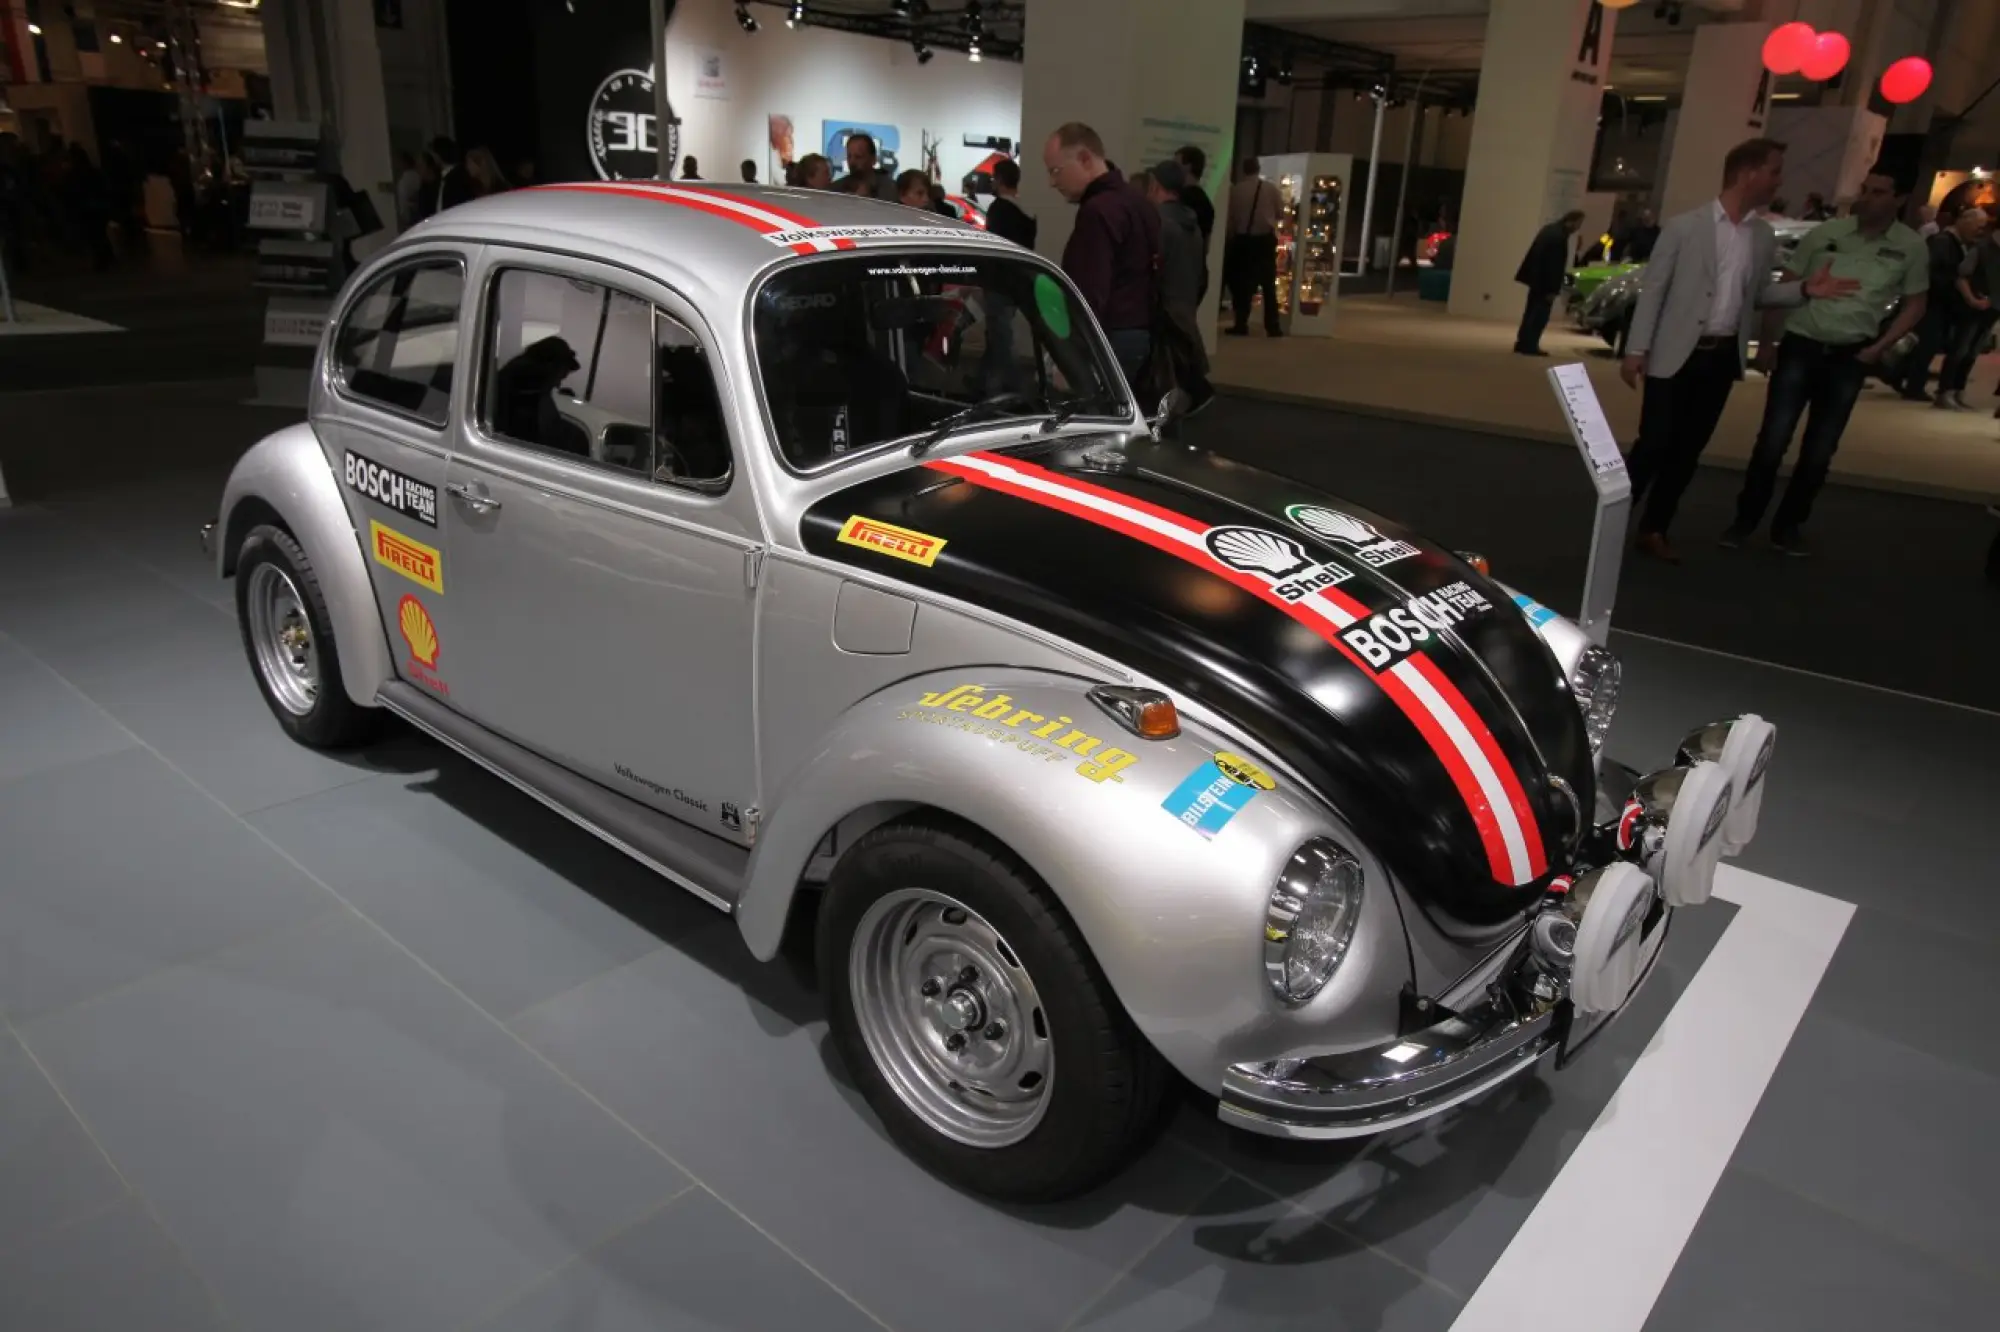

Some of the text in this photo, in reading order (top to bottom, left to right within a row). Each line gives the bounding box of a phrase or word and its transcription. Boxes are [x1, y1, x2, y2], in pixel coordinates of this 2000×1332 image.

[346, 452, 404, 510] BOSCH
[405, 479, 435, 501] RACING
[405, 491, 435, 517] TEAM
[377, 530, 434, 583] PIRELLI
[848, 521, 935, 558] PIRELLI
[1360, 540, 1419, 567] Shell
[1276, 562, 1350, 601] Shell
[1448, 589, 1488, 613] TEAM
[1342, 591, 1465, 668] BOSCH
[407, 660, 450, 697] Shell
[918, 684, 1139, 783] Sebring
[613, 760, 709, 813] Volkswagen Classic
[1180, 775, 1237, 826] BILSTEIN
